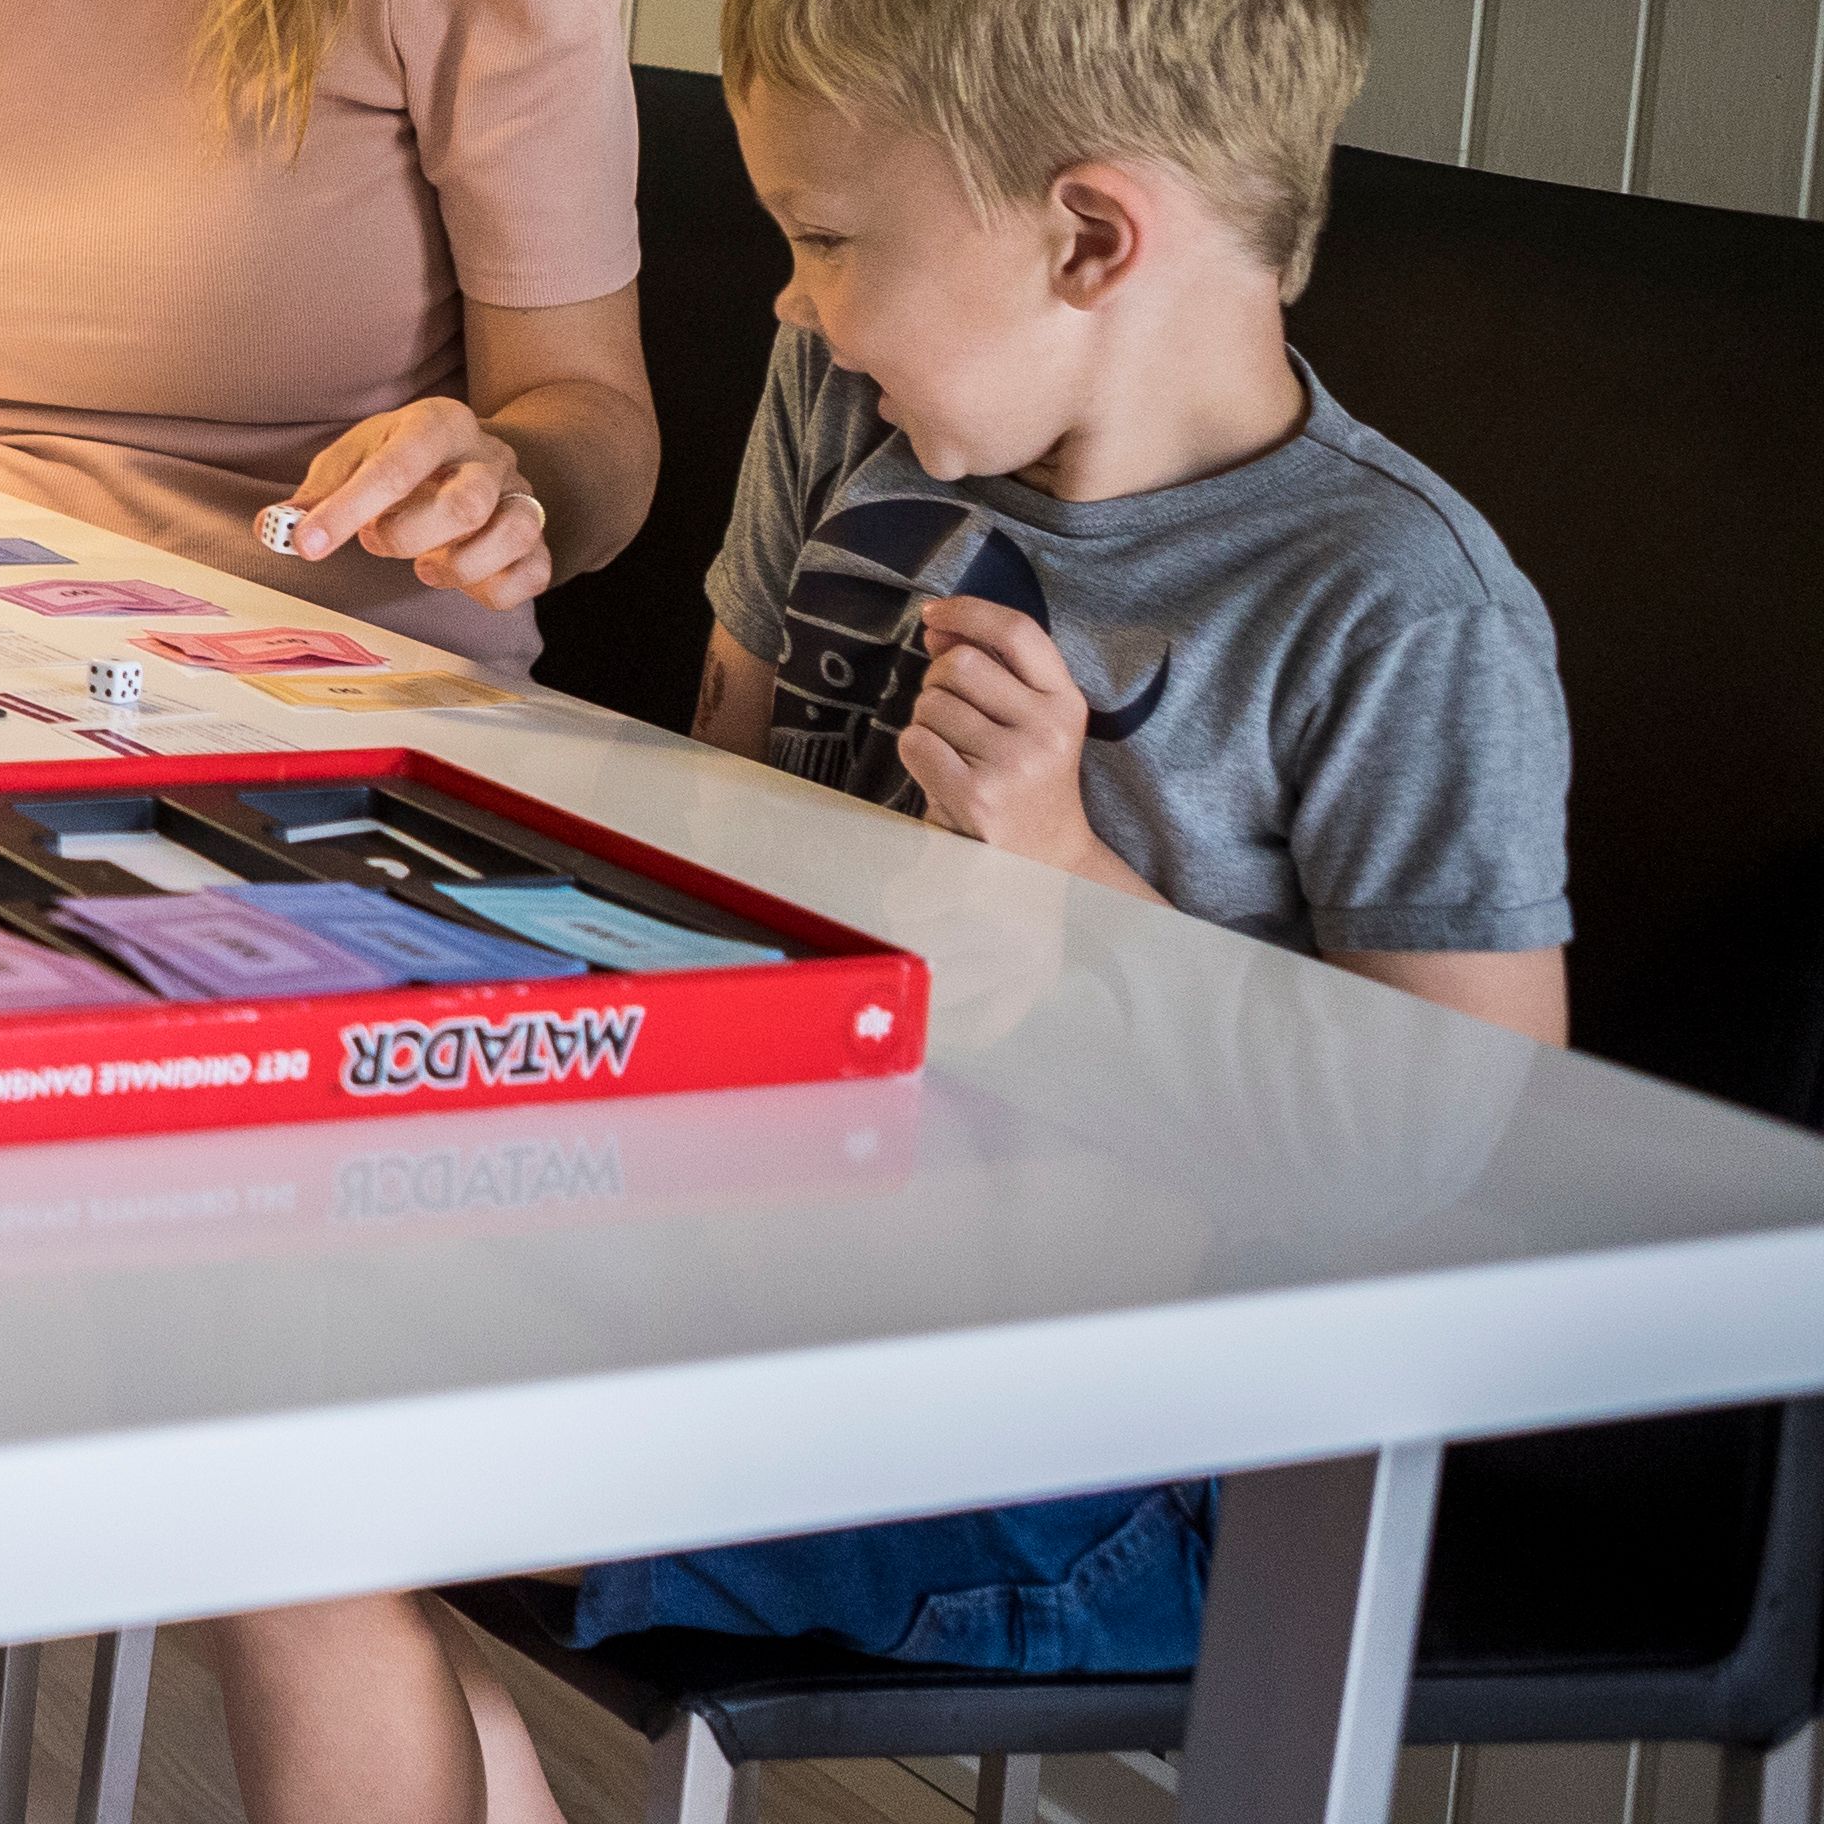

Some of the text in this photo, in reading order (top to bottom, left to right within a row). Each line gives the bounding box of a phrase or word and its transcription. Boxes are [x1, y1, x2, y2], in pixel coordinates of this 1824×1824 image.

[256, 1049, 310, 1083] DET
[339, 1005, 646, 1097] MATADOR
[98, 1053, 252, 1095] ORIGINALE
